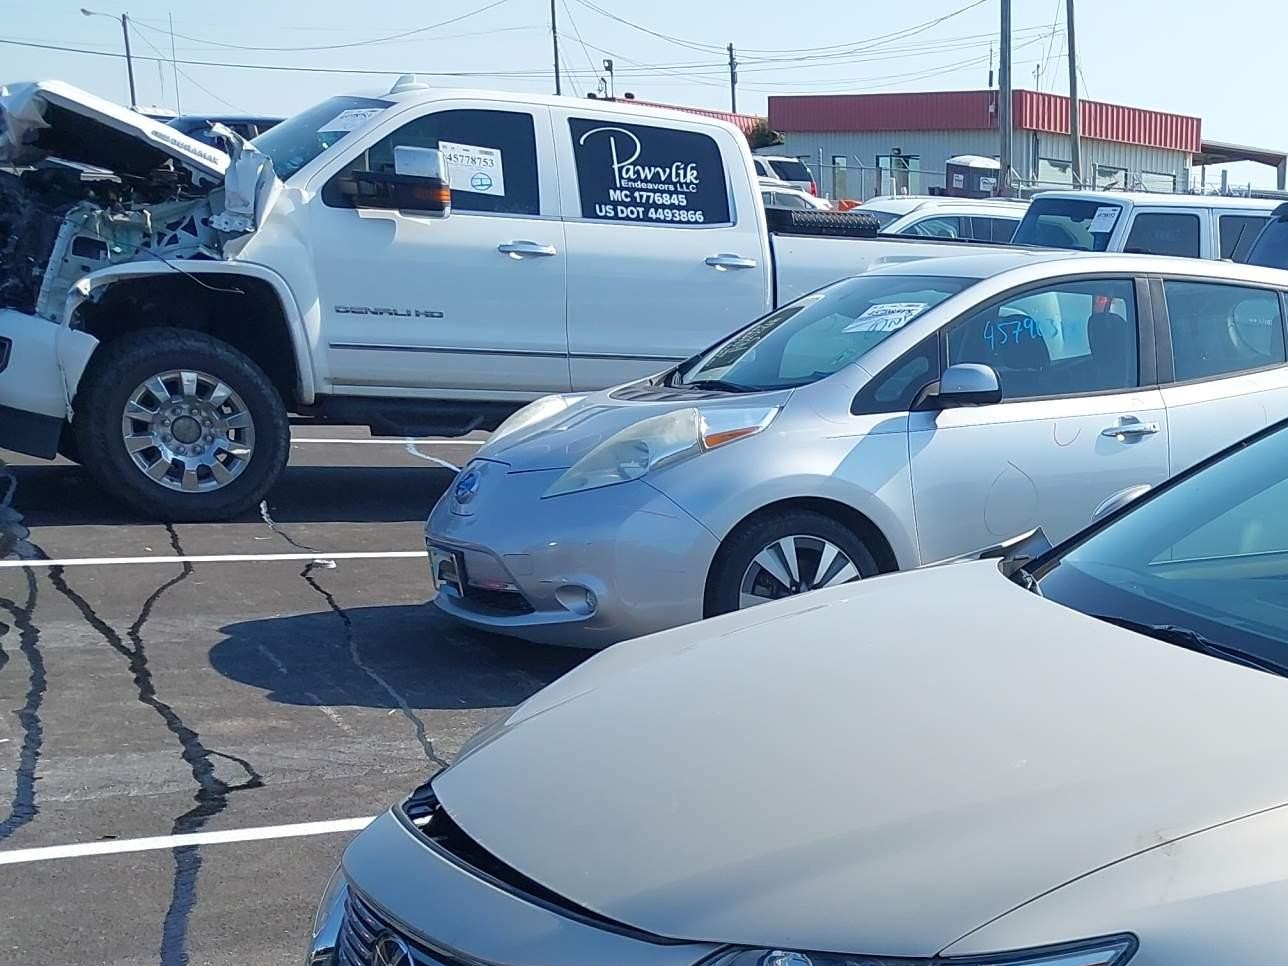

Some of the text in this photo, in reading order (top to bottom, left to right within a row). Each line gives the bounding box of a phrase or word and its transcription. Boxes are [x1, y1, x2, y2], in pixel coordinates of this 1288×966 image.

[580, 127, 700, 187] Pawvlik
[621, 179, 697, 192] Endeavors LLC
[609, 189, 687, 205] MC 1776845
[595, 204, 704, 222] US DOT 4493866
[414, 309, 444, 318] HD
